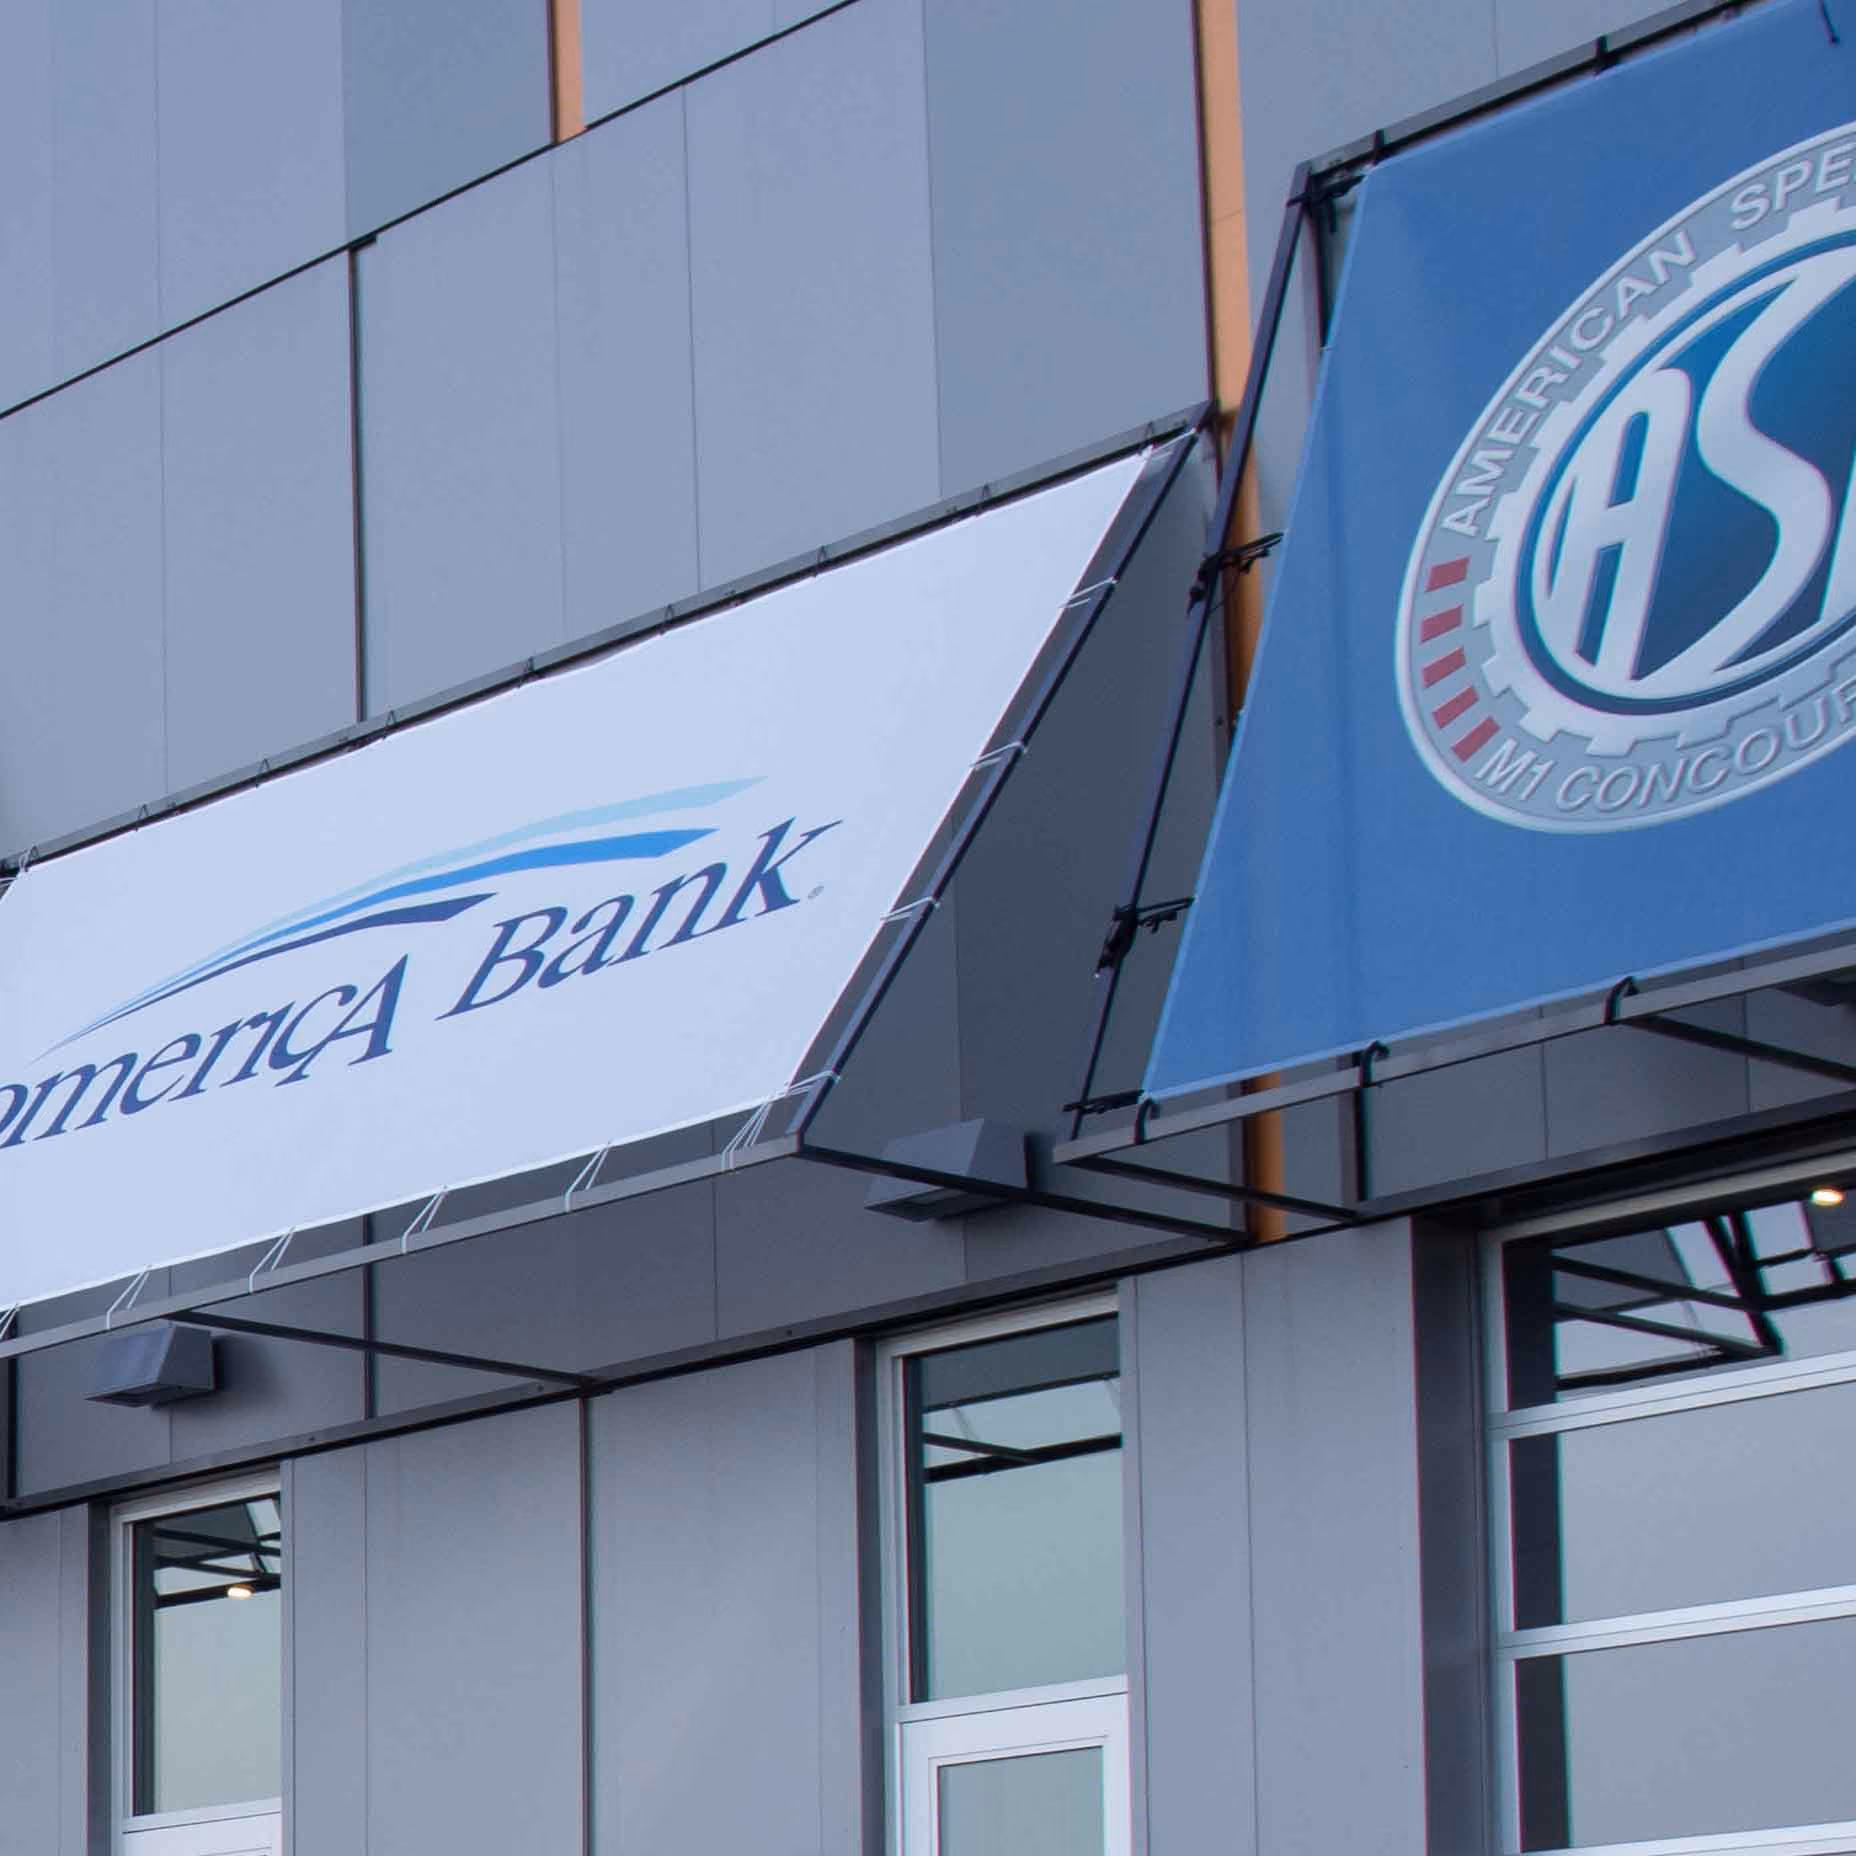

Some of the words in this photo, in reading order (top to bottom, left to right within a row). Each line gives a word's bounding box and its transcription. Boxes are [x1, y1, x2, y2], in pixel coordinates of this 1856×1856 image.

[1441, 229, 1696, 537] AMERICAN
[1533, 240, 1856, 690] AS
[1475, 737, 1556, 801] M1
[435, 816, 844, 1021] Bank
